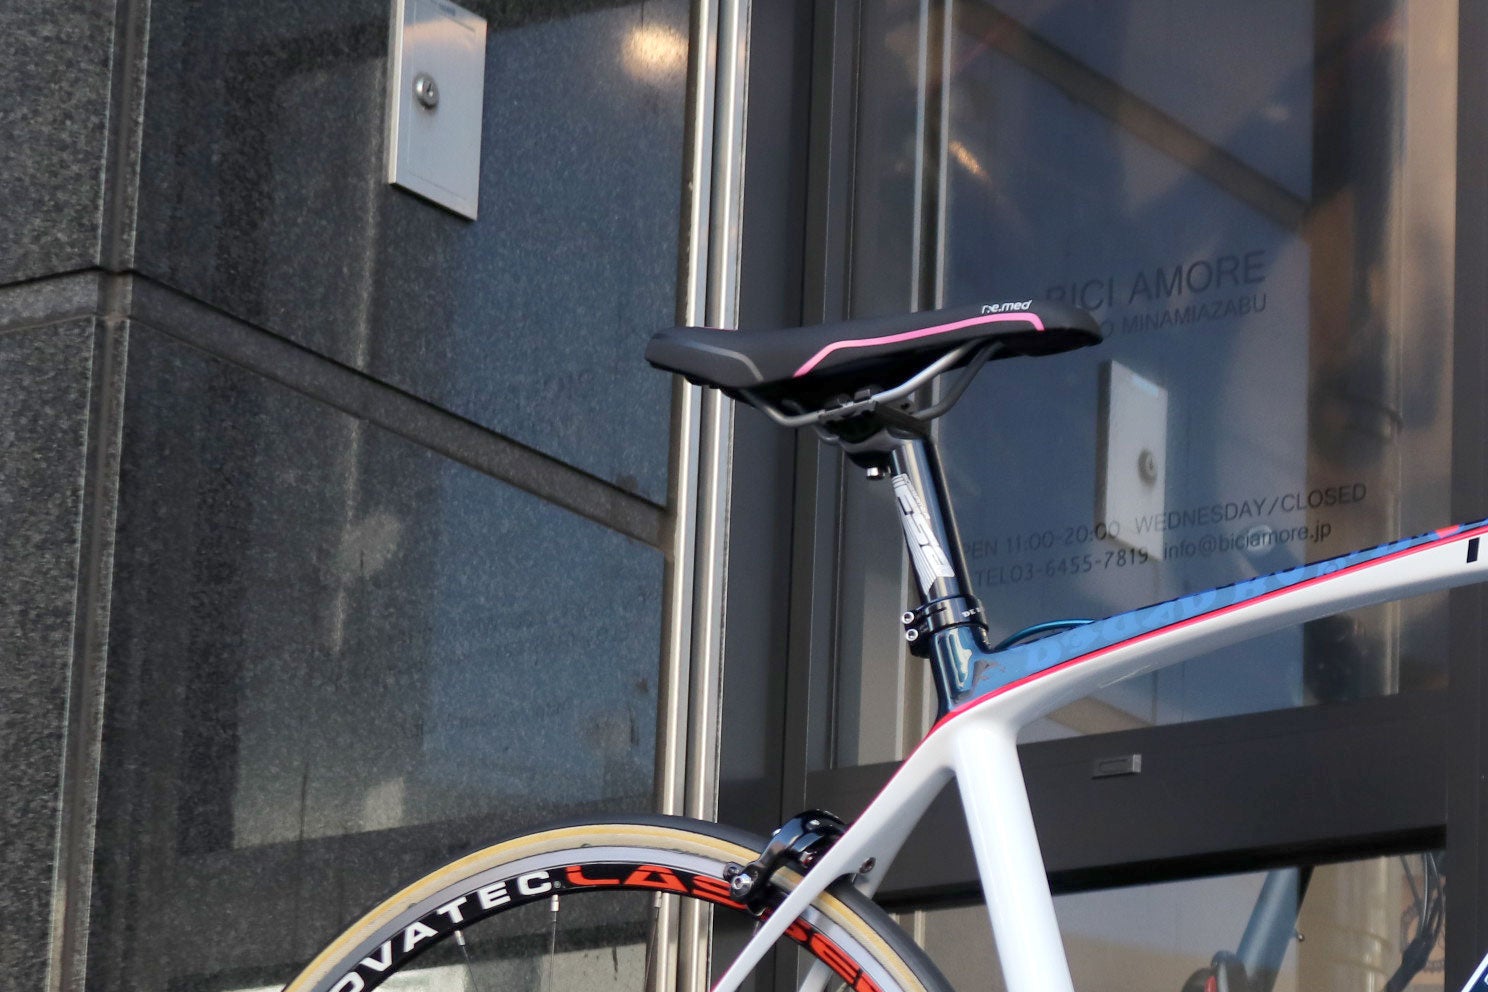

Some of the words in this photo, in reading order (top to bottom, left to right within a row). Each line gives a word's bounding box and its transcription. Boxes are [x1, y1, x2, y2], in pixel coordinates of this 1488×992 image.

[1127, 249, 1266, 305] AMORE
[1121, 294, 1267, 335] MINAMIAZABU
[961, 537, 998, 560] PEN
[1006, 519, 1121, 553] 11:00-20:00
[1133, 483, 1367, 536] WEDNESDAY/CLOSED
[1163, 520, 1333, 560] info@biciamore.jp
